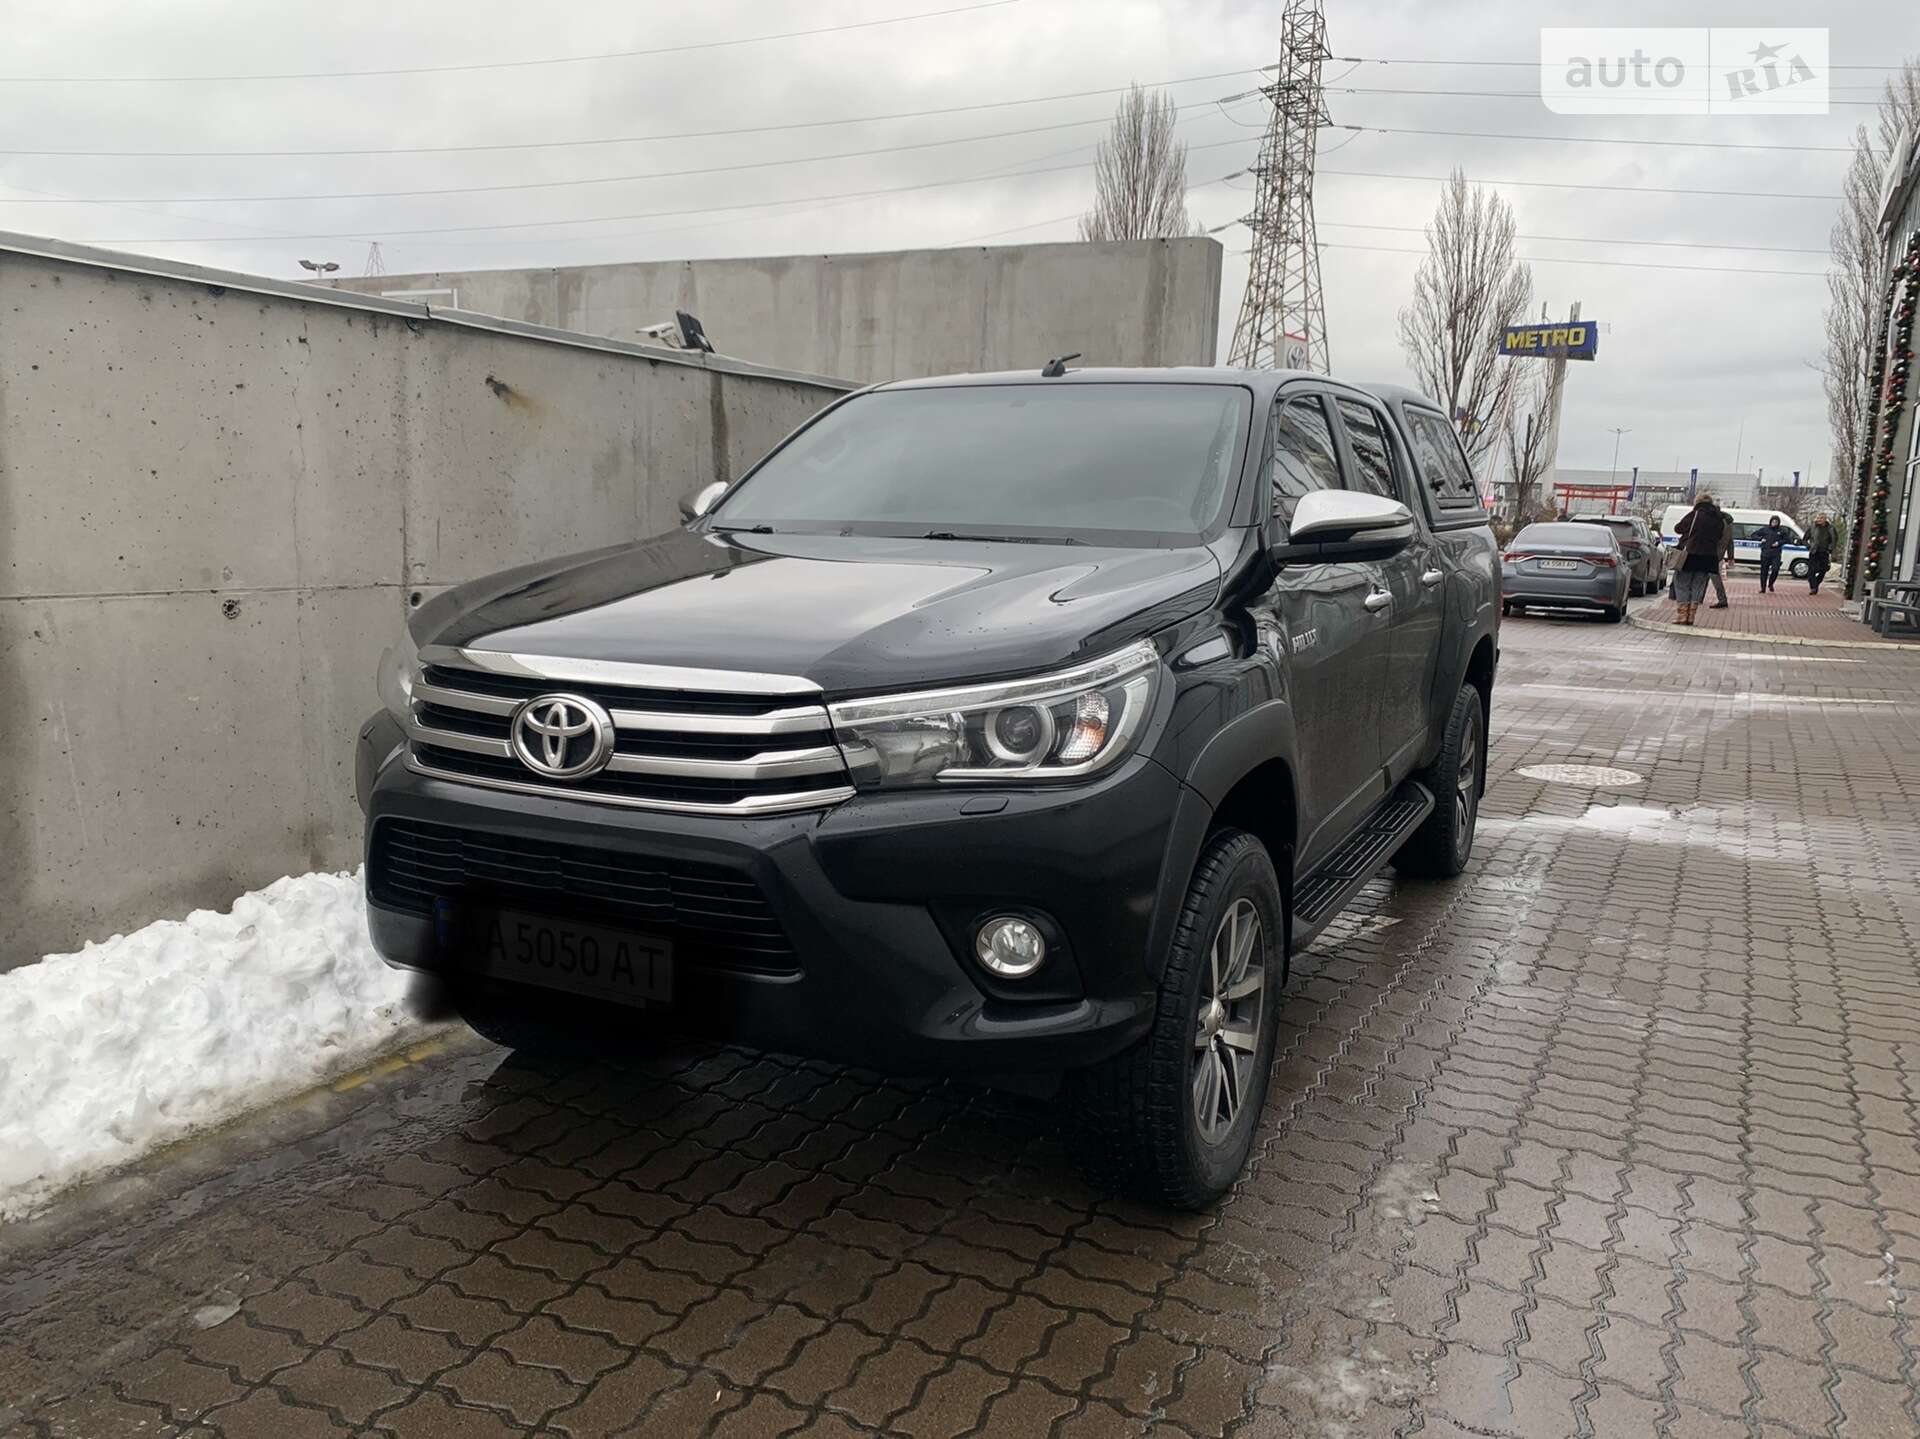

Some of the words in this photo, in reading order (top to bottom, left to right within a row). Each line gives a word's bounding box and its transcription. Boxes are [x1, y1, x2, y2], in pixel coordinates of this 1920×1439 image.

[1506, 328, 1585, 349] METRO
[516, 922, 600, 978] 5050
[610, 941, 665, 990] AT
